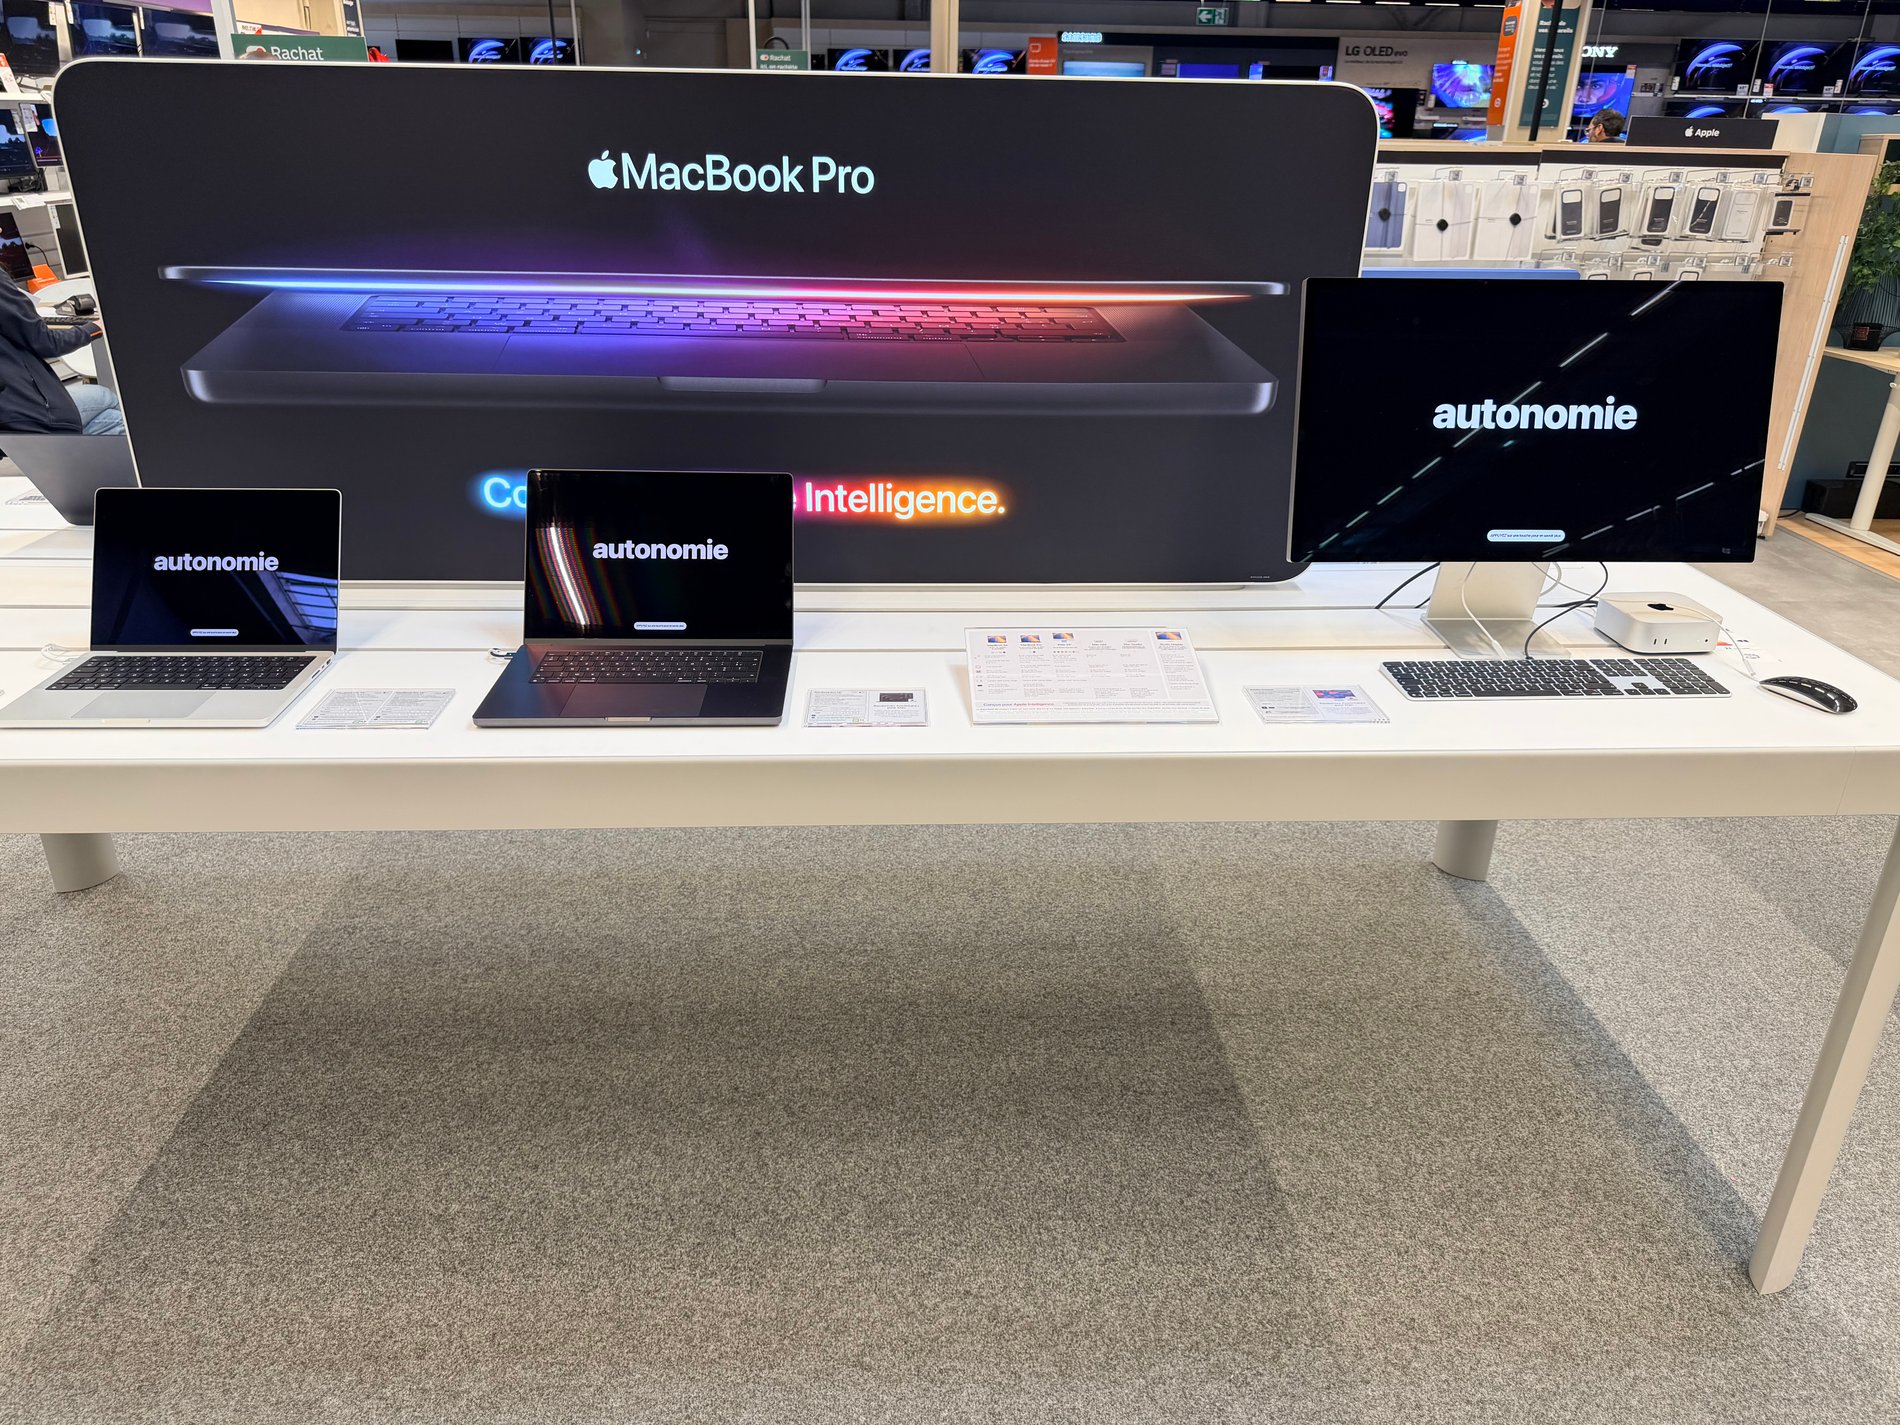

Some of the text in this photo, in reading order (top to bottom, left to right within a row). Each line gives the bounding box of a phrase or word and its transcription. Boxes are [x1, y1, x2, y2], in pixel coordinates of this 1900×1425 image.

[270, 46, 324, 61] Rachat
[1345, 45, 1360, 56] LG
[1363, 45, 1394, 56] OLED
[1581, 45, 1619, 58] ONY
[1694, 128, 1720, 138] Apple
[621, 152, 875, 195] MacBook Pro
[1432, 395, 1638, 430] autonomie
[805, 481, 1006, 520] Intelligence.
[592, 538, 729, 561] autonomie
[153, 551, 280, 572] autonomie
